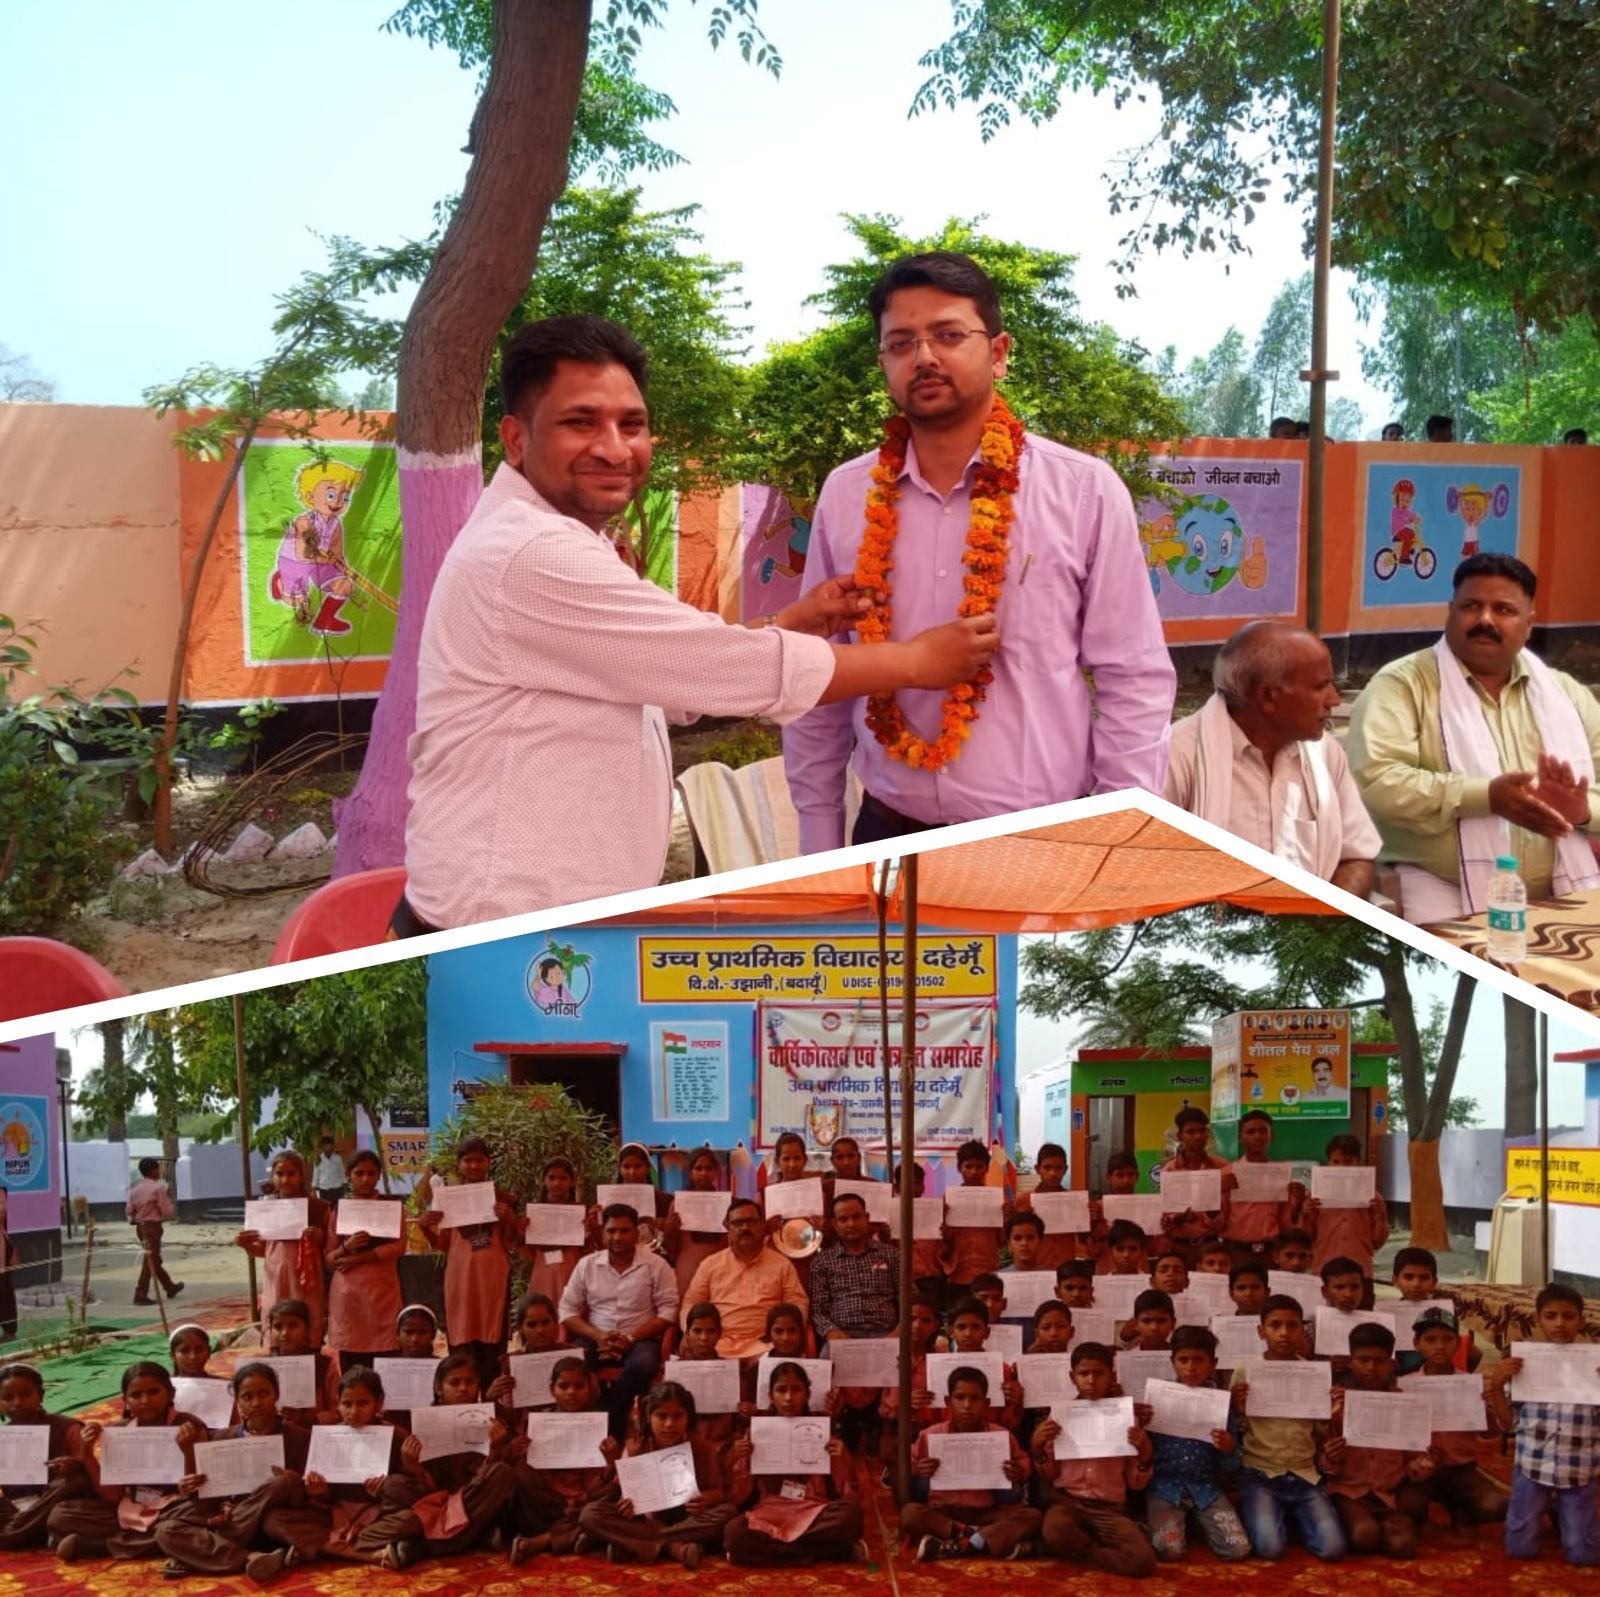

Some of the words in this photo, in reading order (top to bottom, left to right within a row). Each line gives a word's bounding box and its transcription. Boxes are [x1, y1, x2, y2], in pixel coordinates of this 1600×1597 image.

[1156, 466, 1196, 485] बचाओ
[1205, 466, 1240, 486] जीवन
[1243, 468, 1281, 486] बचाओ
[651, 951, 699, 969] उच्च
[706, 944, 805, 971] प्राथमिक
[922, 941, 985, 975] दहेमूँ
[854, 1040, 878, 1068] एवं
[931, 1040, 984, 1068] समारोह
[788, 1078, 814, 1093] उच्च
[817, 1076, 870, 1093] प्राथमिक
